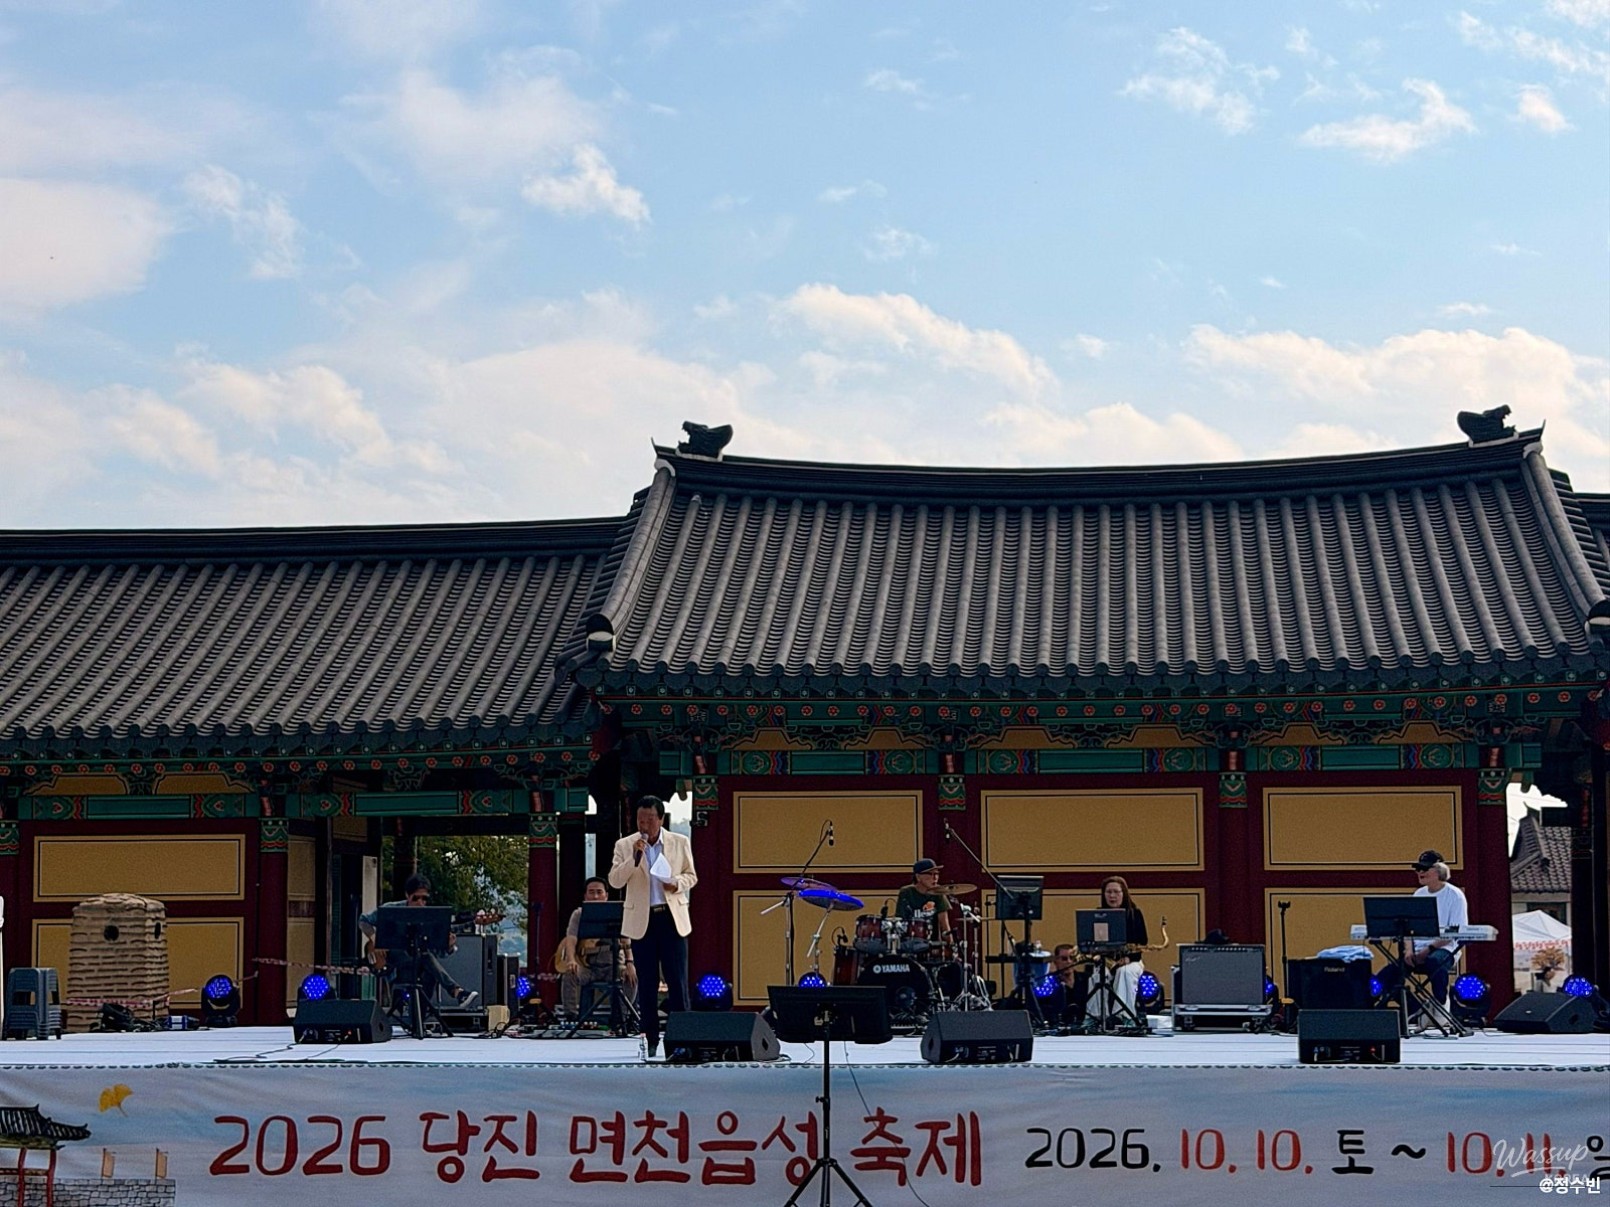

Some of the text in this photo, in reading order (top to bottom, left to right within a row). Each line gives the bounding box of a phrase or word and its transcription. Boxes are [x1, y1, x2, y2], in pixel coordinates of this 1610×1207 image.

[882, 964, 911, 973] YAMAHA
[209, 1107, 982, 1187] 2026 당진 면천읍성 축제
[1025, 1127, 1162, 1173] 2026.
[1180, 1128, 1238, 1175] 10.
[1256, 1129, 1314, 1175] 10.
[1331, 1129, 1375, 1175] 토
